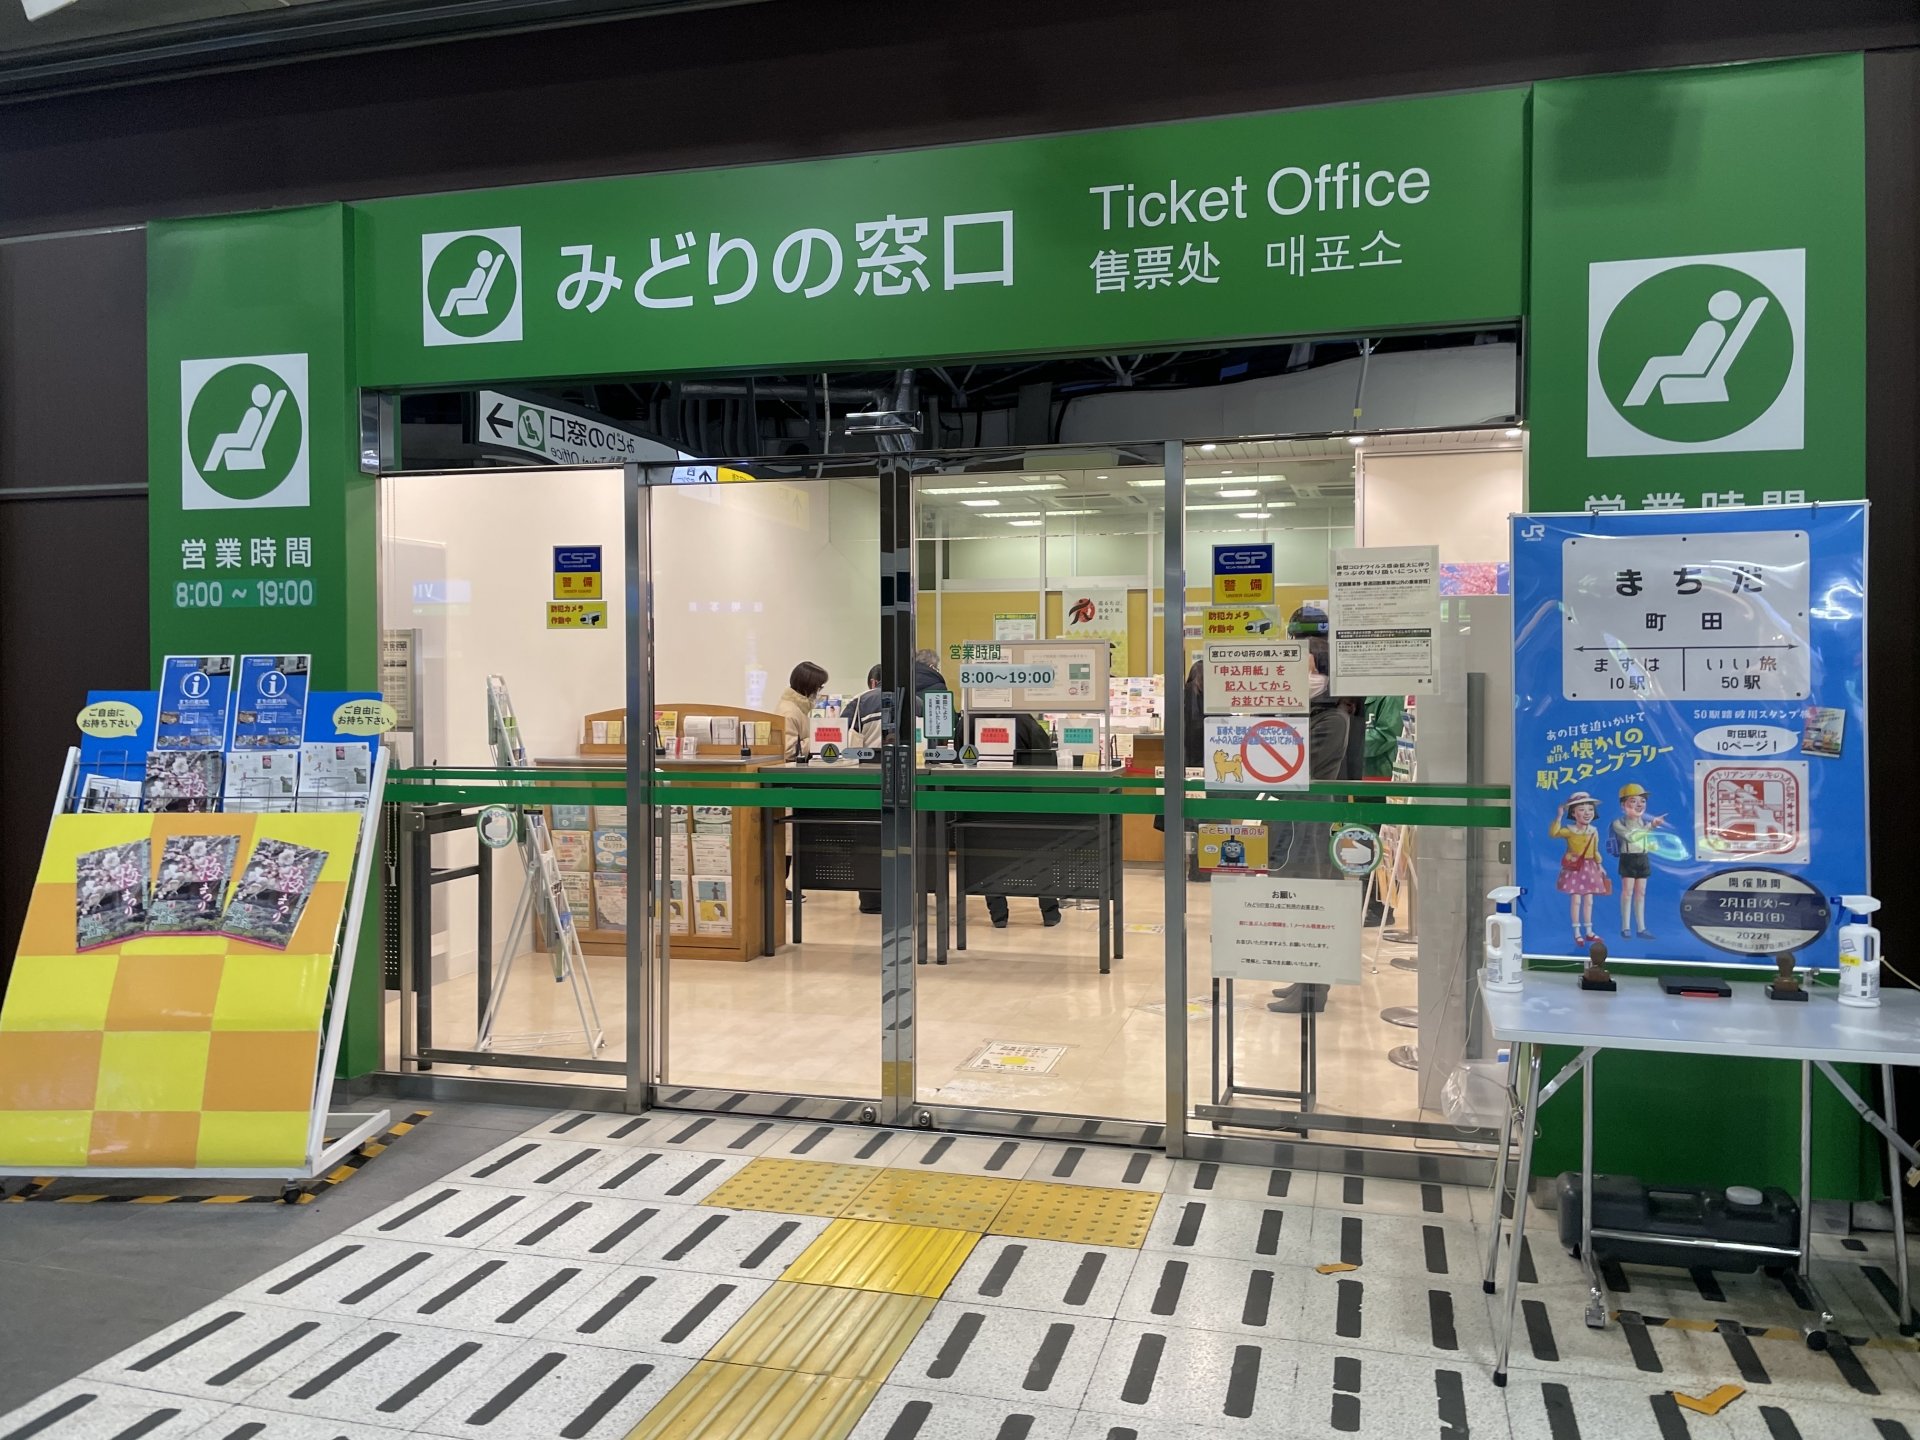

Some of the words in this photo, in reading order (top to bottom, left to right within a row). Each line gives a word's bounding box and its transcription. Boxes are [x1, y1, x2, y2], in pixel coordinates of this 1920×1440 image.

[1089, 175, 1248, 232] Ticket
[1266, 161, 1432, 217] Office
[1266, 228, 1404, 277] 매표소
[555, 208, 1015, 313] みどりの窓口
[1089, 240, 1221, 294] 售票处
[1521, 524, 1546, 538] JR
[181, 536, 312, 570] 営業時間
[558, 552, 597, 564] CSP
[1218, 551, 1268, 565] CSP
[1223, 578, 1263, 592] 警備
[1615, 566, 1763, 597] まちだ
[176, 581, 223, 608] 8:00
[256, 579, 313, 607] 19:00
[1208, 611, 1250, 621] 防犯カメラ
[1645, 612, 1723, 632] 町田
[1208, 624, 1235, 634] 作動中
[950, 643, 1001, 661] 営業時間
[1212, 648, 1299, 658] 窓口での切符の購入・変更
[1593, 657, 1660, 673] まずは
[1706, 655, 1777, 672] いい旅
[1214, 664, 1286, 677] 「申込用紙」を
[1225, 680, 1292, 692] 記入してから
[1231, 695, 1304, 707] お並び下さい。
[88, 708, 126, 718] ご自由に
[344, 705, 382, 715] ご自由に
[82, 719, 138, 729] お持ち下さい。
[337, 716, 394, 726] お持ち下さい。
[1546, 711, 1646, 742] あの日を追いかけて
[1726, 729, 1768, 739] 町田駅は
[1570, 727, 1644, 760] 懐かしの
[1536, 745, 1675, 791] 駅スタンプラリー
[1201, 826, 1265, 837] こども110番の駅
[1728, 877, 1781, 889] 開催期間
[1271, 890, 1297, 900] お願い
[1724, 911, 1785, 923] 3月6日(日)
[1736, 931, 1771, 940] 2022年
